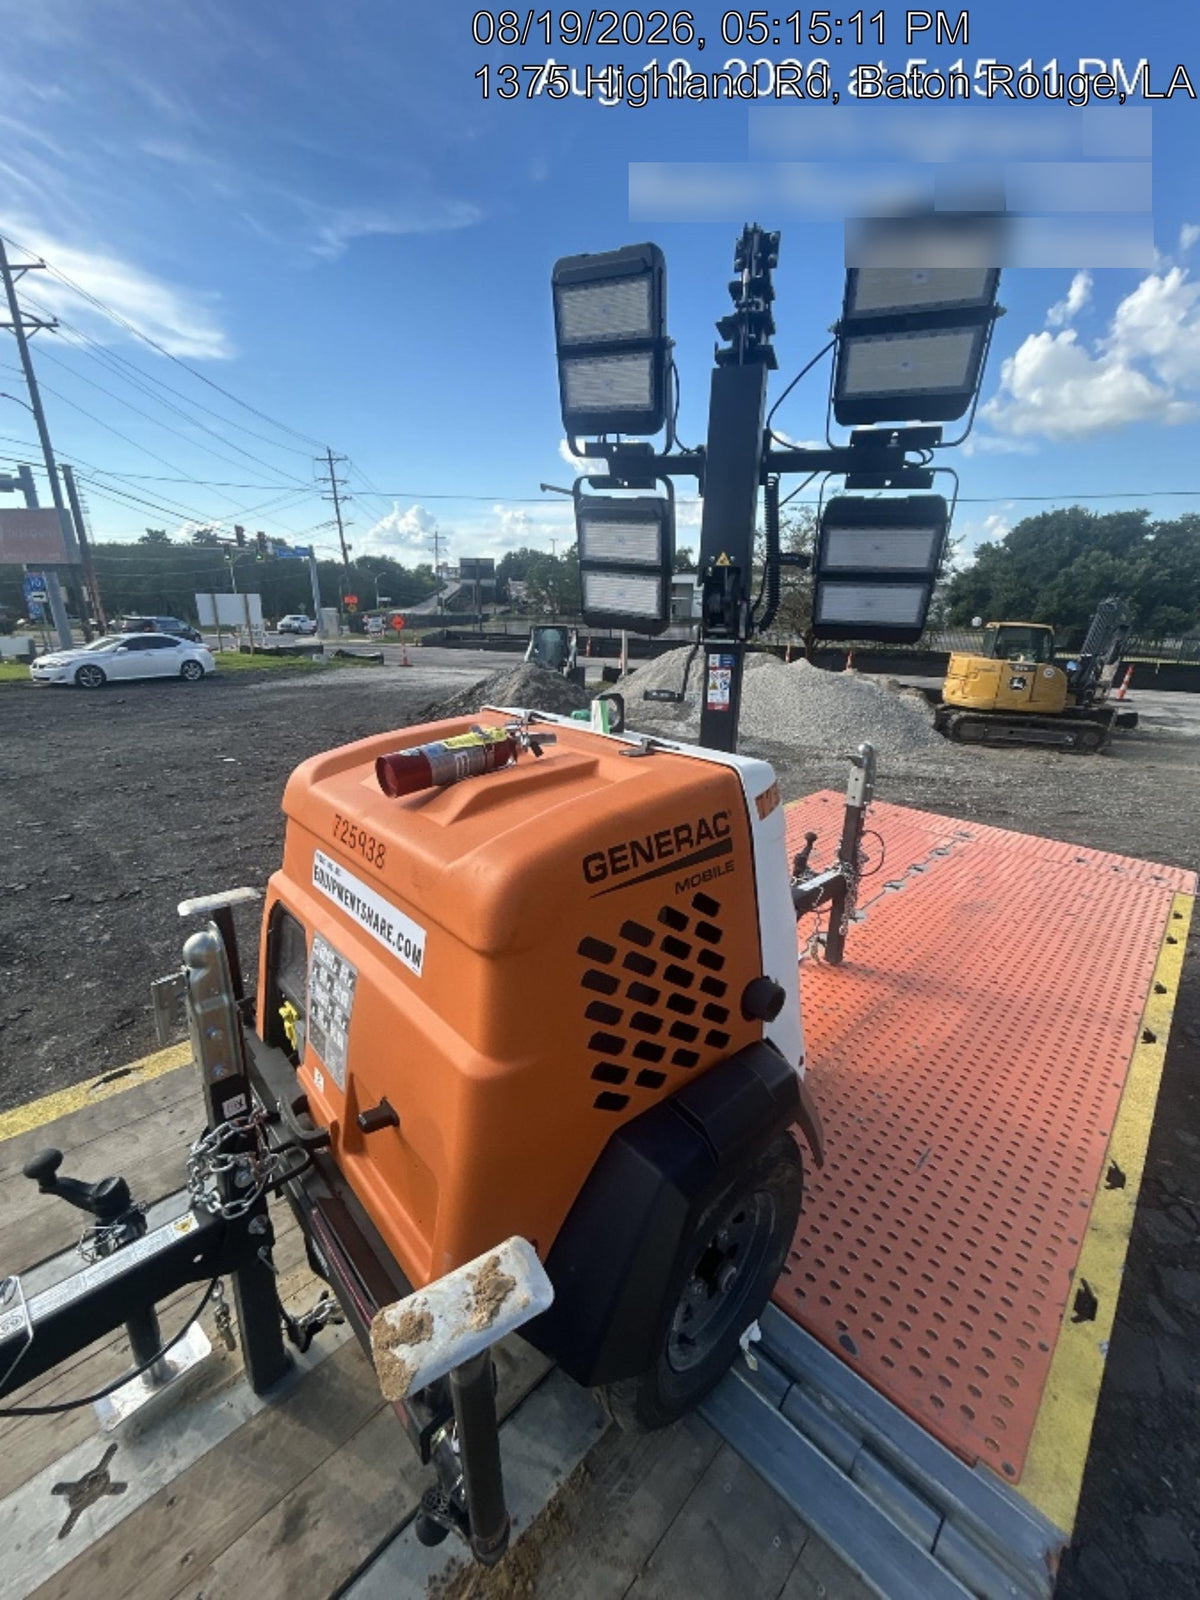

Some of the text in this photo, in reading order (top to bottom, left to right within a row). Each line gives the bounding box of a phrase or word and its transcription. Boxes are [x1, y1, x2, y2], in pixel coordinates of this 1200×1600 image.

[333, 813, 387, 870] 725938
[582, 810, 732, 884] GENERAC
[674, 860, 736, 895] MOBILE
